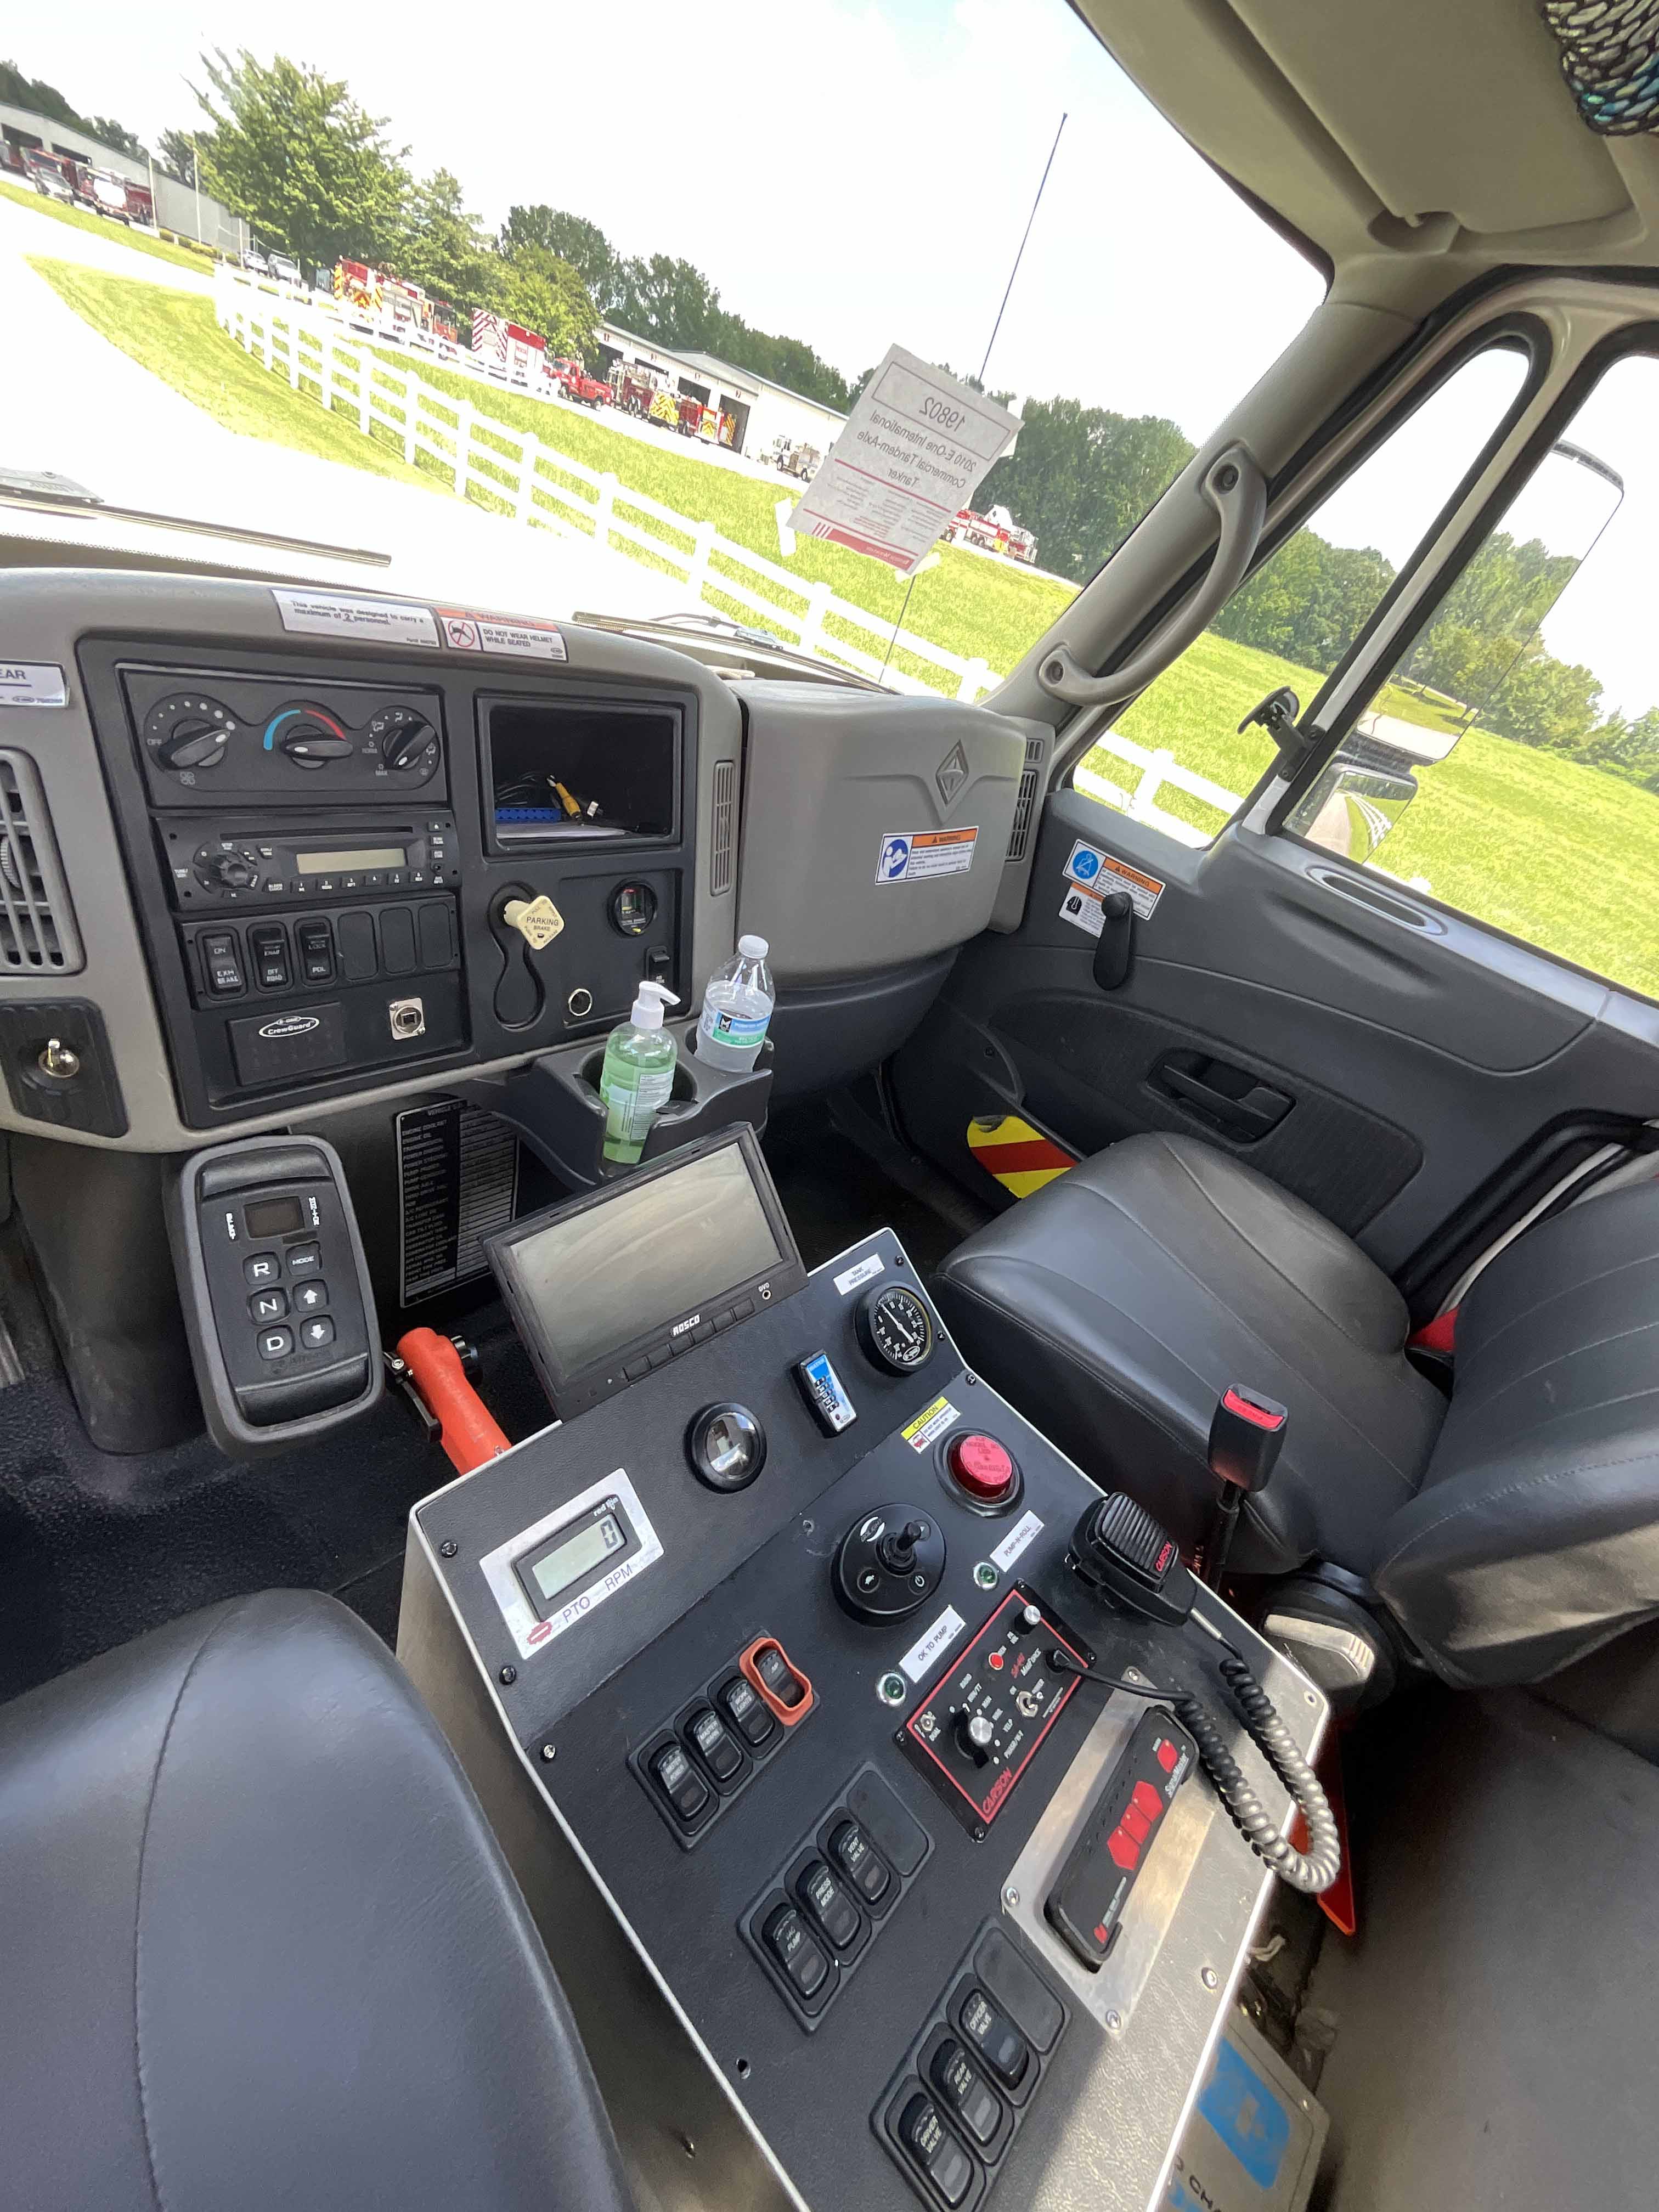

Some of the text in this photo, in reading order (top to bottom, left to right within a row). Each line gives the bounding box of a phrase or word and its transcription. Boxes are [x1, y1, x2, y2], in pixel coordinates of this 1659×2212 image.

[294, 608, 331, 618] maximum
[357, 609, 387, 618] designed
[507, 639, 531, 647] SEATED
[1121, 868, 1150, 887] WARNING
[527, 917, 558, 926] PARKING
[268, 1022, 311, 1035] CrewGuard
[253, 1262, 272, 1278] R
[292, 1255, 315, 1267] MODE
[259, 1297, 278, 1315] N
[672, 1313, 701, 1337] ROSCO
[266, 1336, 284, 1352] D
[912, 1404, 939, 1430] CAUTION
[1001, 1525, 1032, 1556] PUMP-N-ROLL
[562, 1564, 633, 1624] PTO RPM
[916, 1624, 950, 1661] OK TO PUMP
[733, 1690, 749, 1705] WORK
[735, 1695, 753, 1712] LIGHTS
[698, 1720, 719, 1741] MASTER
[983, 1767, 1013, 1812] CARSON
[846, 1836, 861, 1853] VENT
[814, 1876, 832, 1899] PRESS
[819, 1886, 836, 1906] MODE
[786, 1931, 803, 1953] PUMP
[967, 2000, 989, 2030] OFFICER
[976, 2012, 993, 2035] VALVE
[952, 2062, 968, 2084] REAR
[956, 2069, 974, 2094] VALVE
[918, 2115, 940, 2147] DRIVER
[924, 2126, 944, 2153] VALVE
